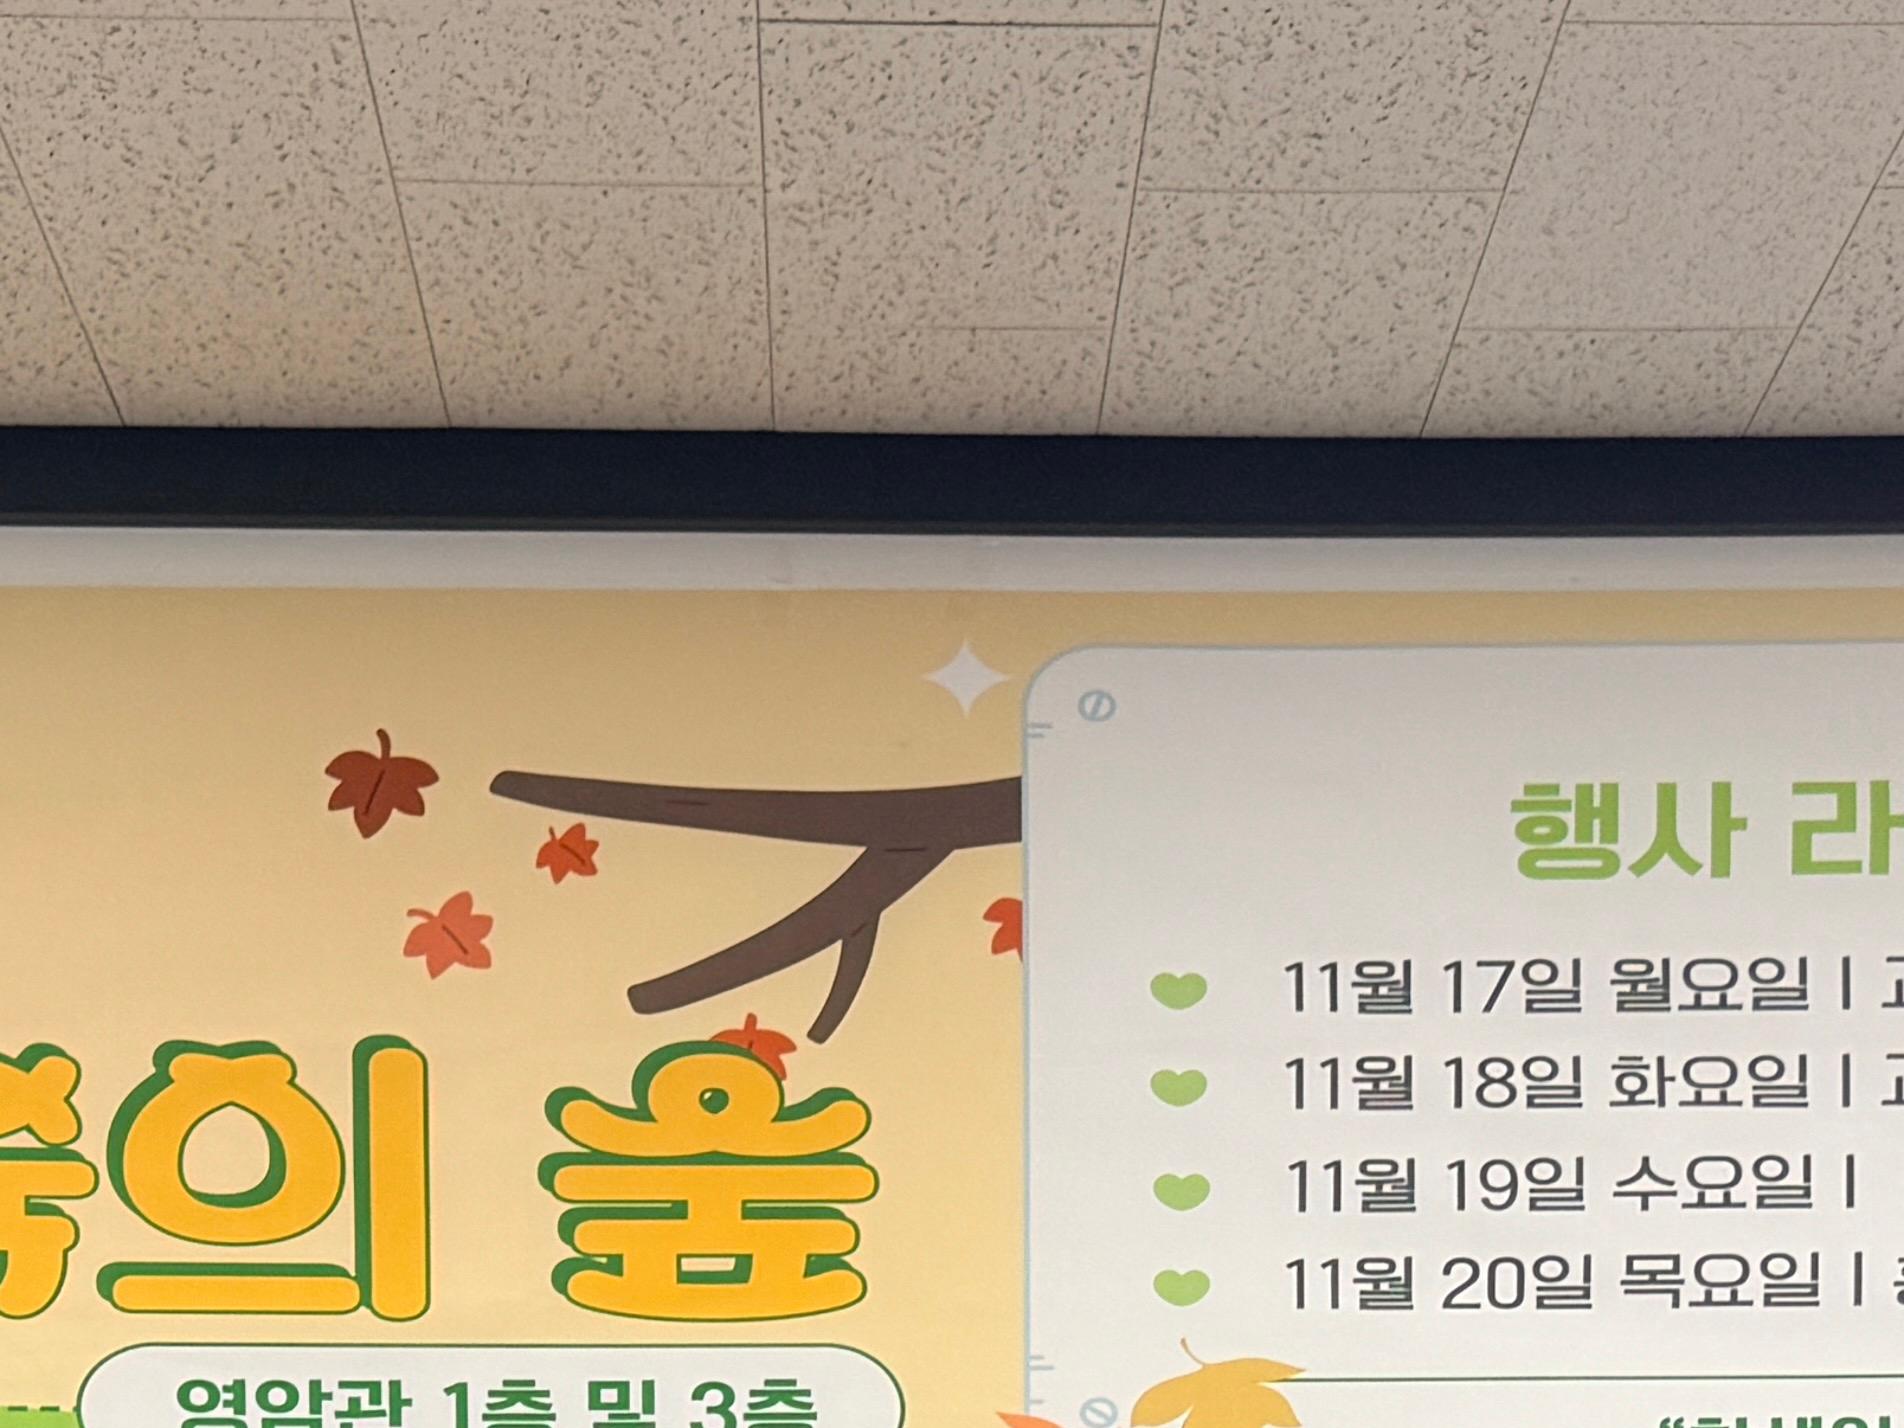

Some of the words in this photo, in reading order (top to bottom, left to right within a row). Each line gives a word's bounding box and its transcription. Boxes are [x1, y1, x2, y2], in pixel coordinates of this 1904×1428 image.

[1510, 778, 1750, 883] 행사
[1282, 958, 1418, 1018] 11월
[1440, 958, 1586, 1018] 17일
[1607, 955, 1813, 1016] 월요일
[1282, 1053, 1418, 1114] 11월
[1440, 1053, 1586, 1114] 18일
[1607, 1052, 1813, 1114] 화요일
[1285, 1156, 1420, 1217] 11월
[1444, 1156, 1590, 1217] 19일
[1613, 1153, 1819, 1217] 수요일
[1283, 1254, 1418, 1315] 11월
[1440, 1254, 1595, 1315] 20일
[1618, 1250, 1825, 1314] 목요일
